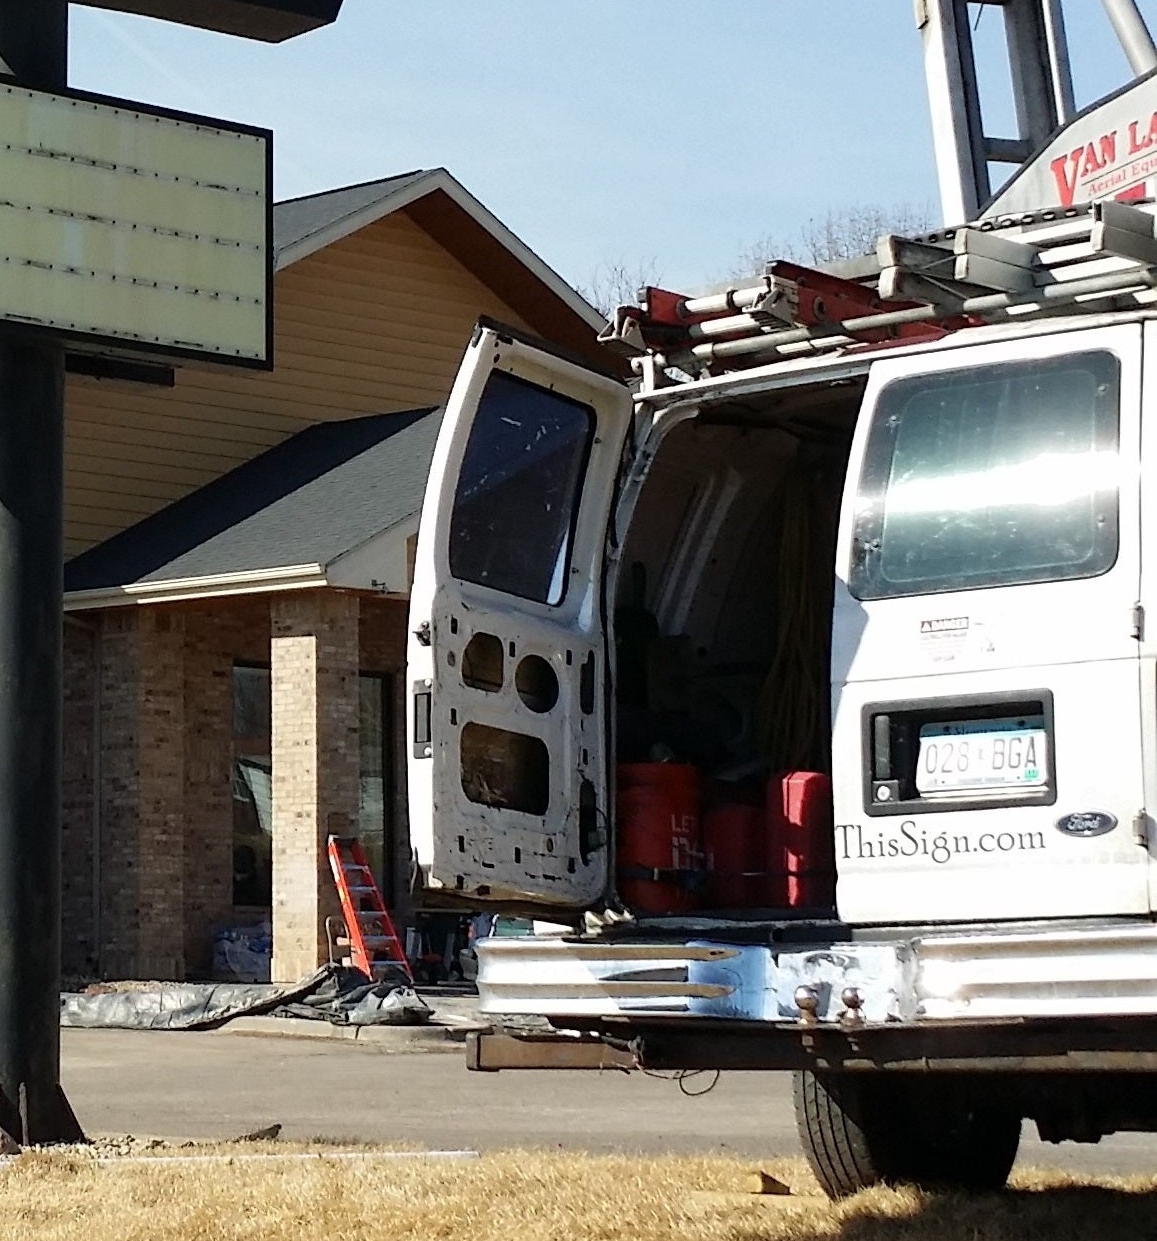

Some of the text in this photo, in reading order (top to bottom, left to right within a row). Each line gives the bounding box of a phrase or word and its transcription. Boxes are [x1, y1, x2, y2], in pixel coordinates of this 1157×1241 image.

[1050, 130, 1117, 209] VAN
[1087, 170, 1127, 197] Aerial
[925, 736, 1037, 774] 028 BGA
[835, 821, 1046, 863] ThisSign.com
